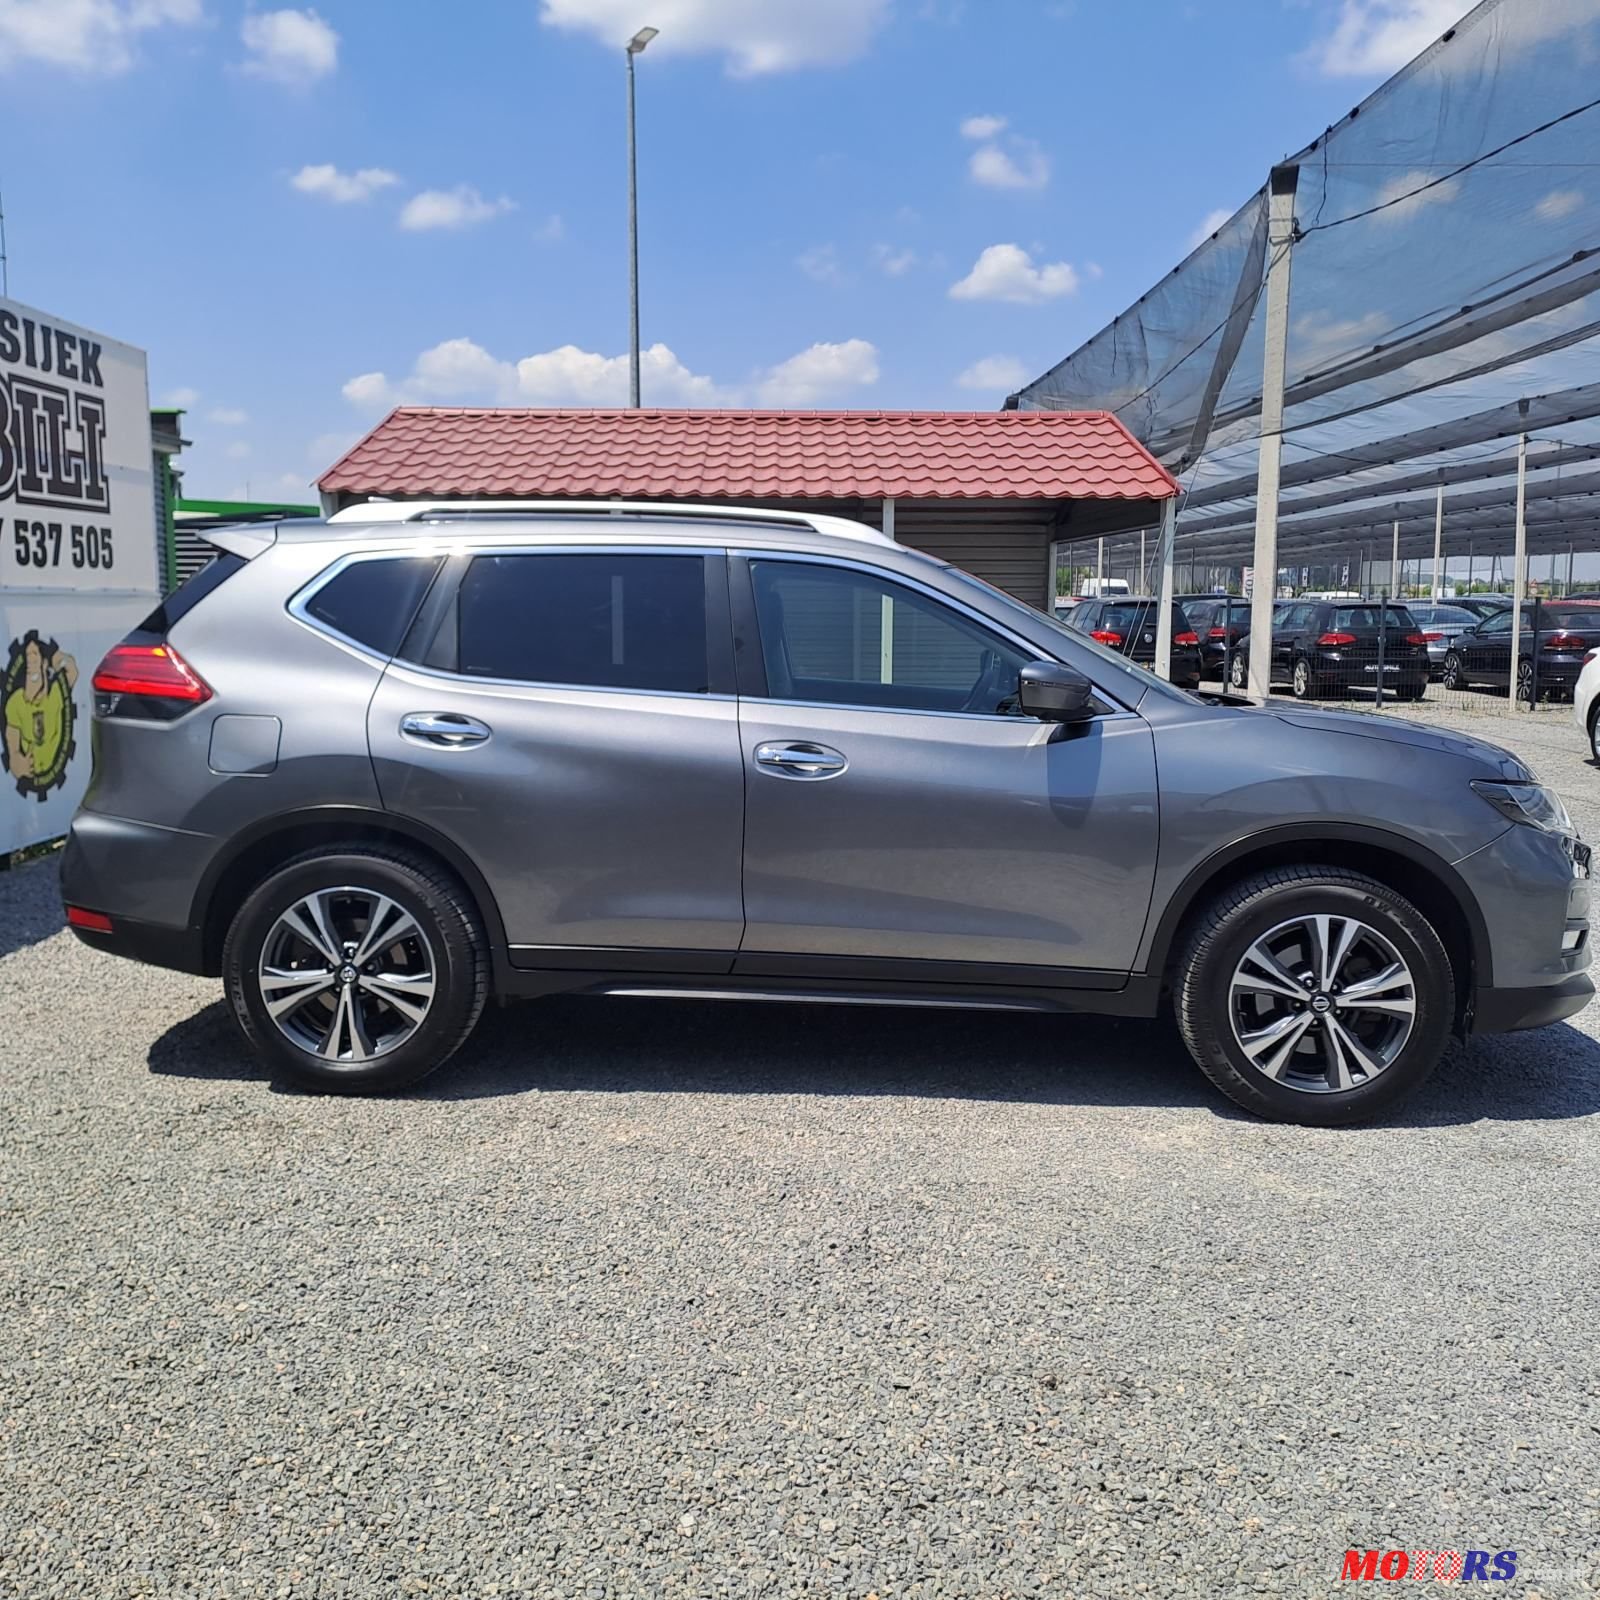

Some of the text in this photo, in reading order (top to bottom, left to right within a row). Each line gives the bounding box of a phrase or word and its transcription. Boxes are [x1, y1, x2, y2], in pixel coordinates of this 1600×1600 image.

[0, 309, 103, 388] SIJEK
[14, 519, 62, 568] 537
[71, 525, 113, 570] 505
